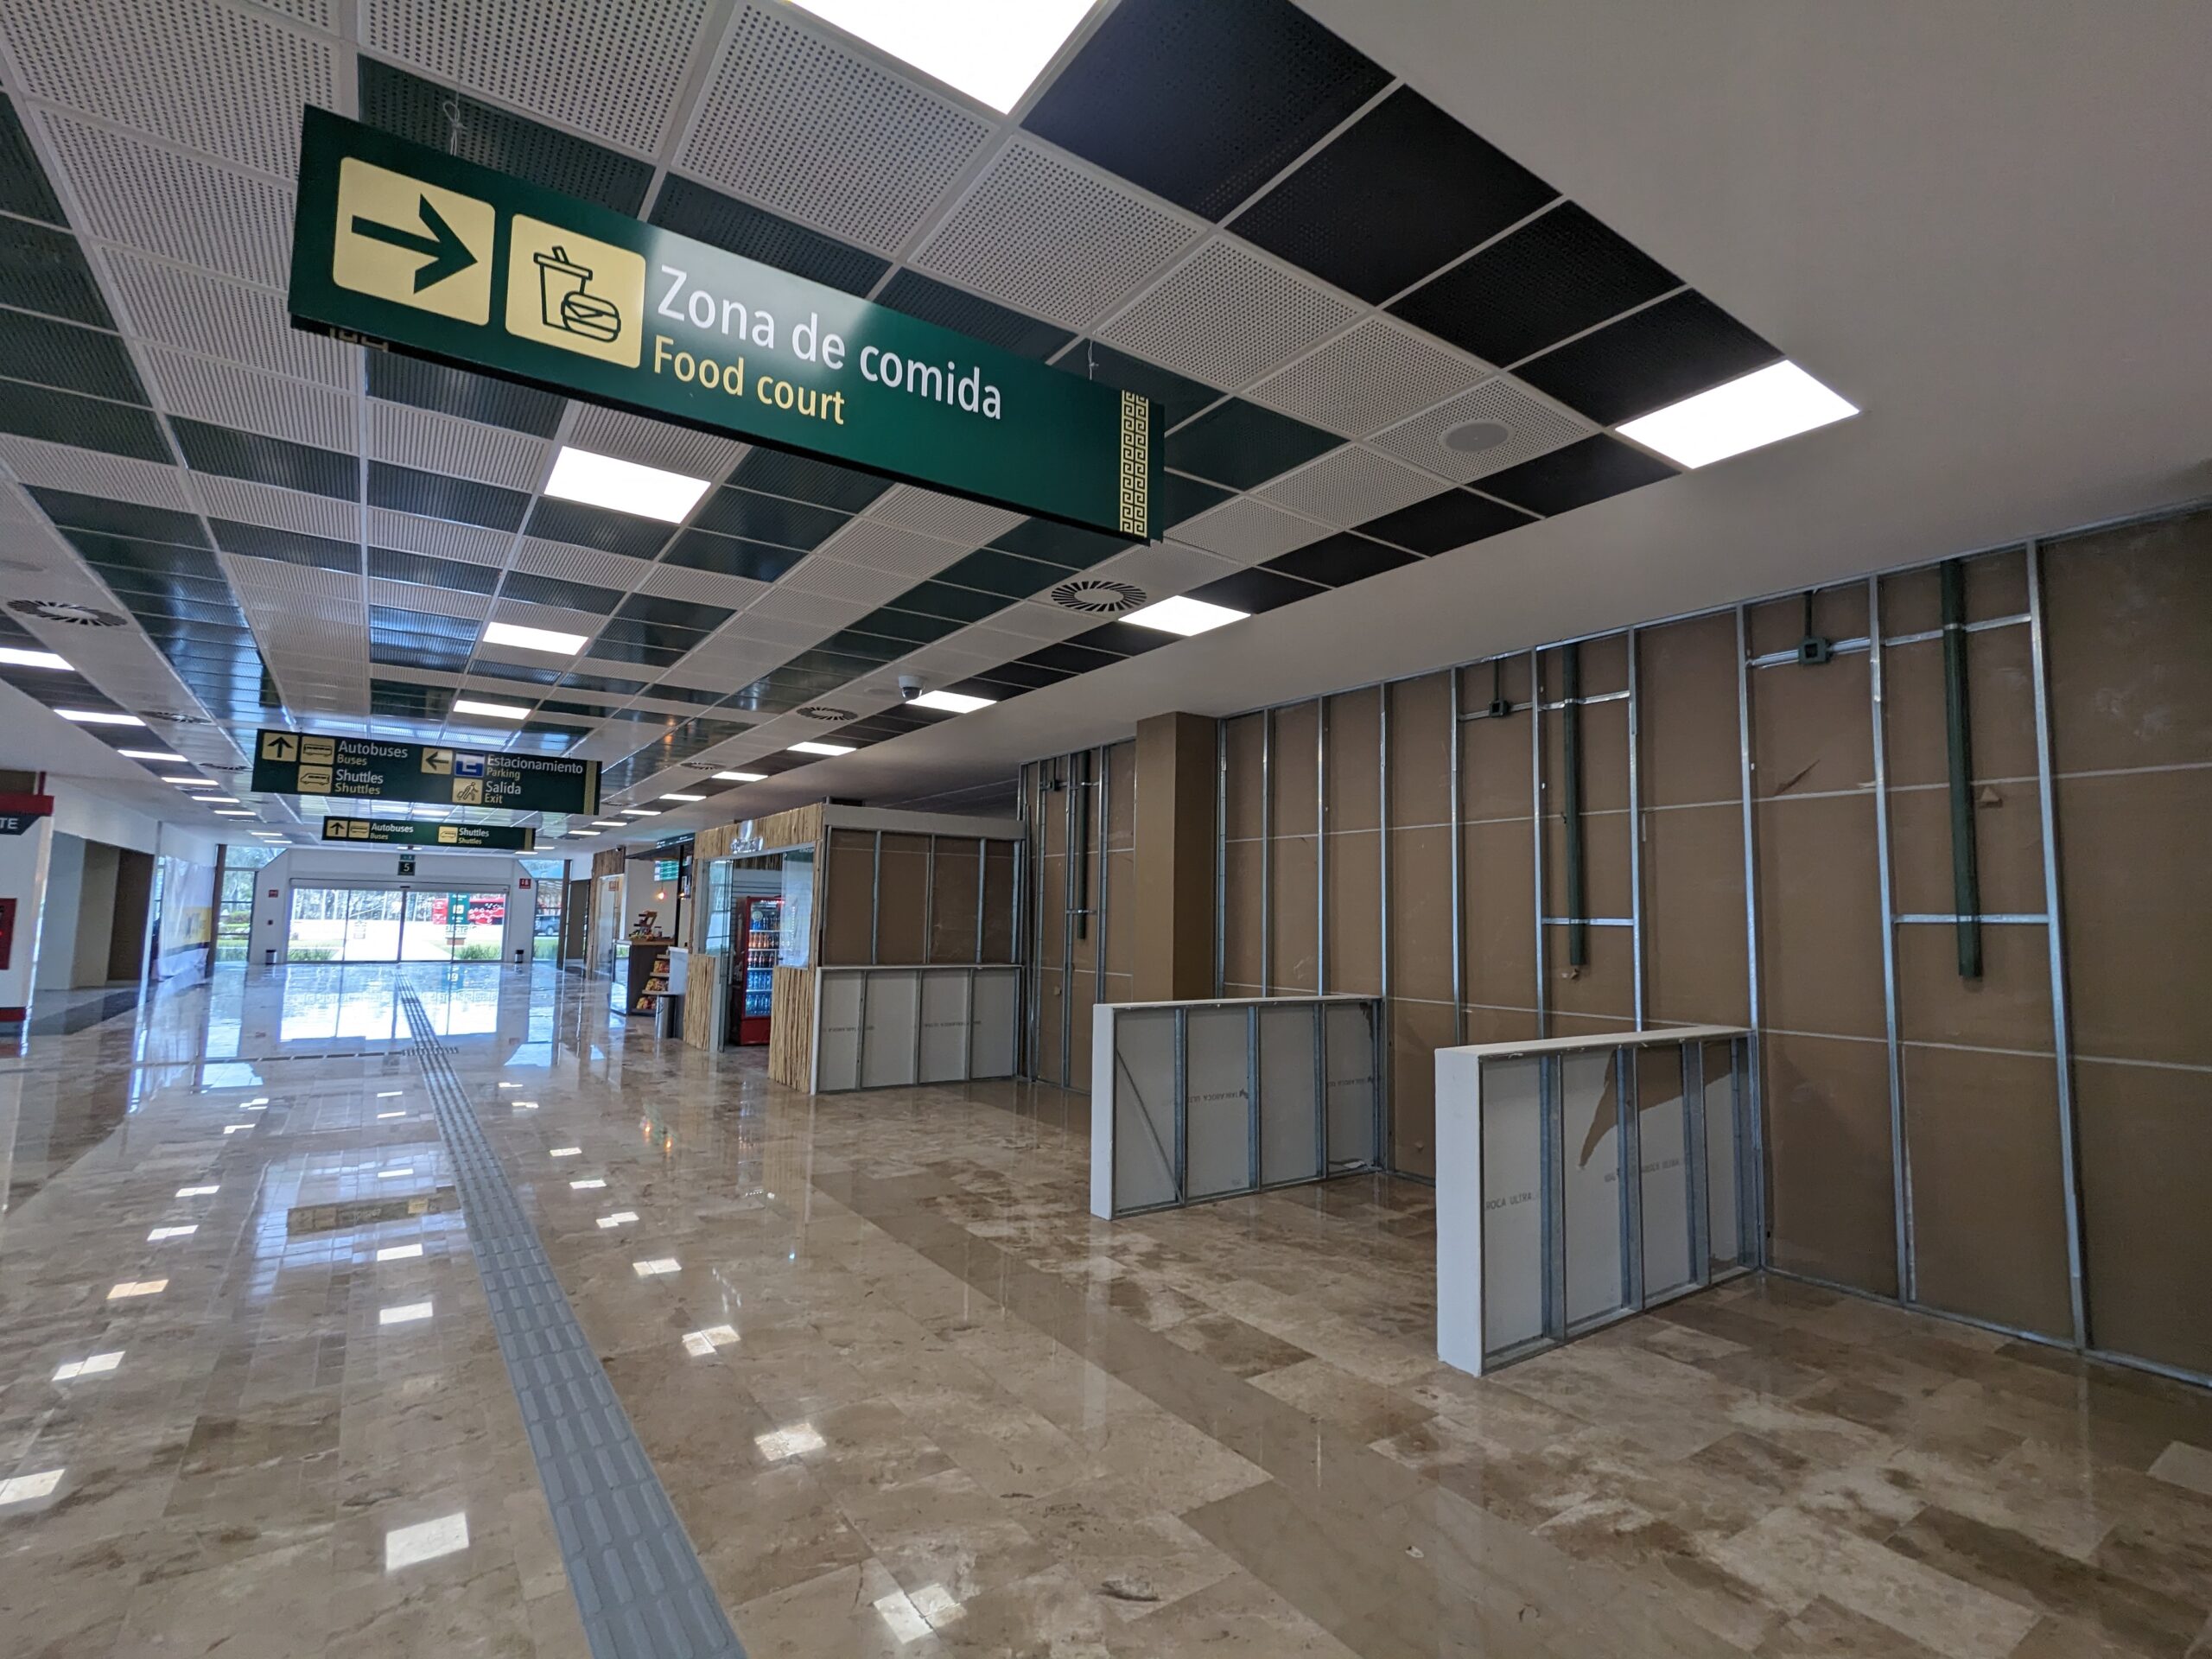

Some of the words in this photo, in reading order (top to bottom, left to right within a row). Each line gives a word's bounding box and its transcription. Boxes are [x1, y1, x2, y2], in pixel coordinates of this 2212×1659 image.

[658, 264, 775, 349] Zona
[791, 311, 846, 371] de
[860, 345, 1001, 421] comida
[653, 334, 745, 397] Food
[756, 377, 845, 425] court
[338, 740, 409, 759] Autobuses
[336, 753, 368, 766] Buses
[486, 753, 584, 775] Estacionamiento
[335, 768, 384, 785] Shuttles
[486, 766, 521, 781] Parking
[334, 782, 381, 795] Shuttles
[485, 780, 522, 796] Salida
[484, 792, 503, 804] Exit
[371, 822, 415, 833] Autobuses
[458, 827, 490, 838] Shuttles
[404, 862, 410, 872] 5
